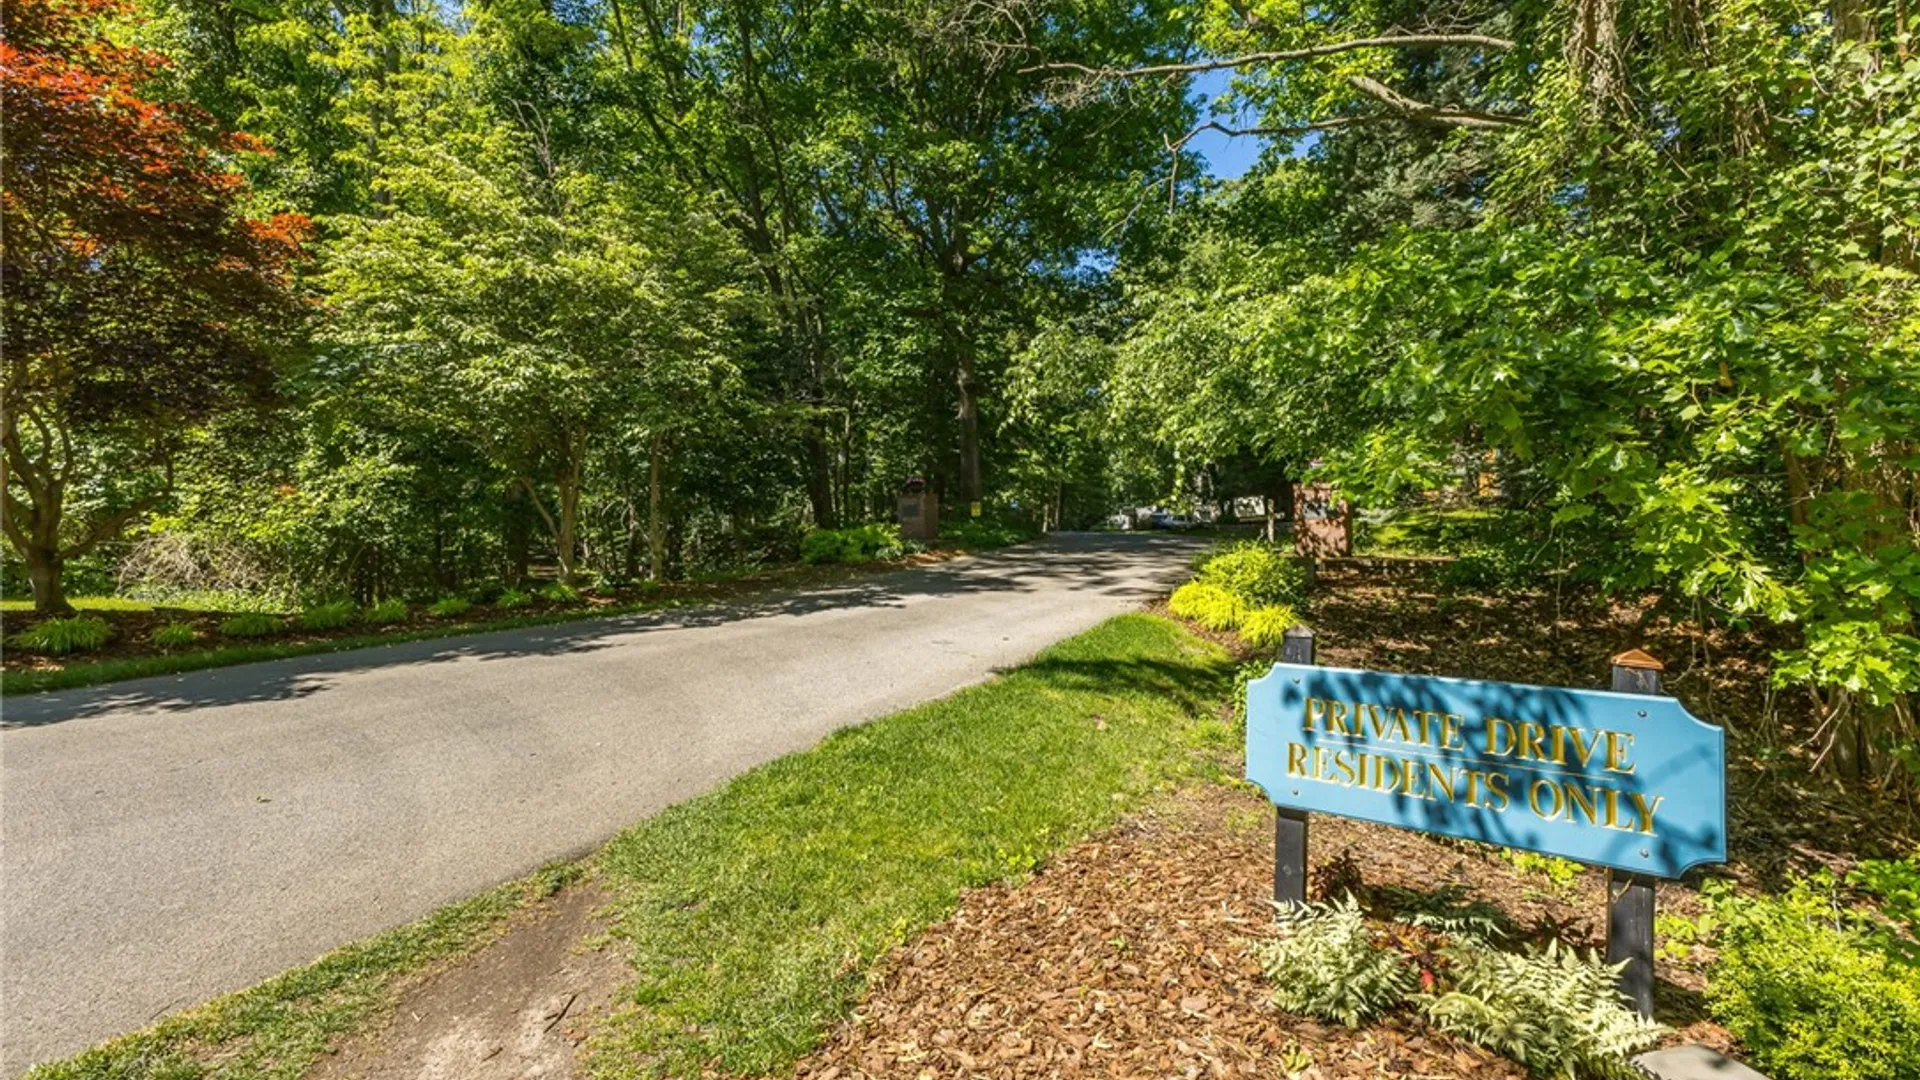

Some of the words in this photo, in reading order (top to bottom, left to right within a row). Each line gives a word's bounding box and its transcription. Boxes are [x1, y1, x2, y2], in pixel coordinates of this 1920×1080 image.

[1302, 697, 1463, 750] PRIVATE
[1484, 718, 1635, 774] DRIVE
[1286, 743, 1510, 812] RESIDENTS
[1529, 780, 1664, 836] ONLY
